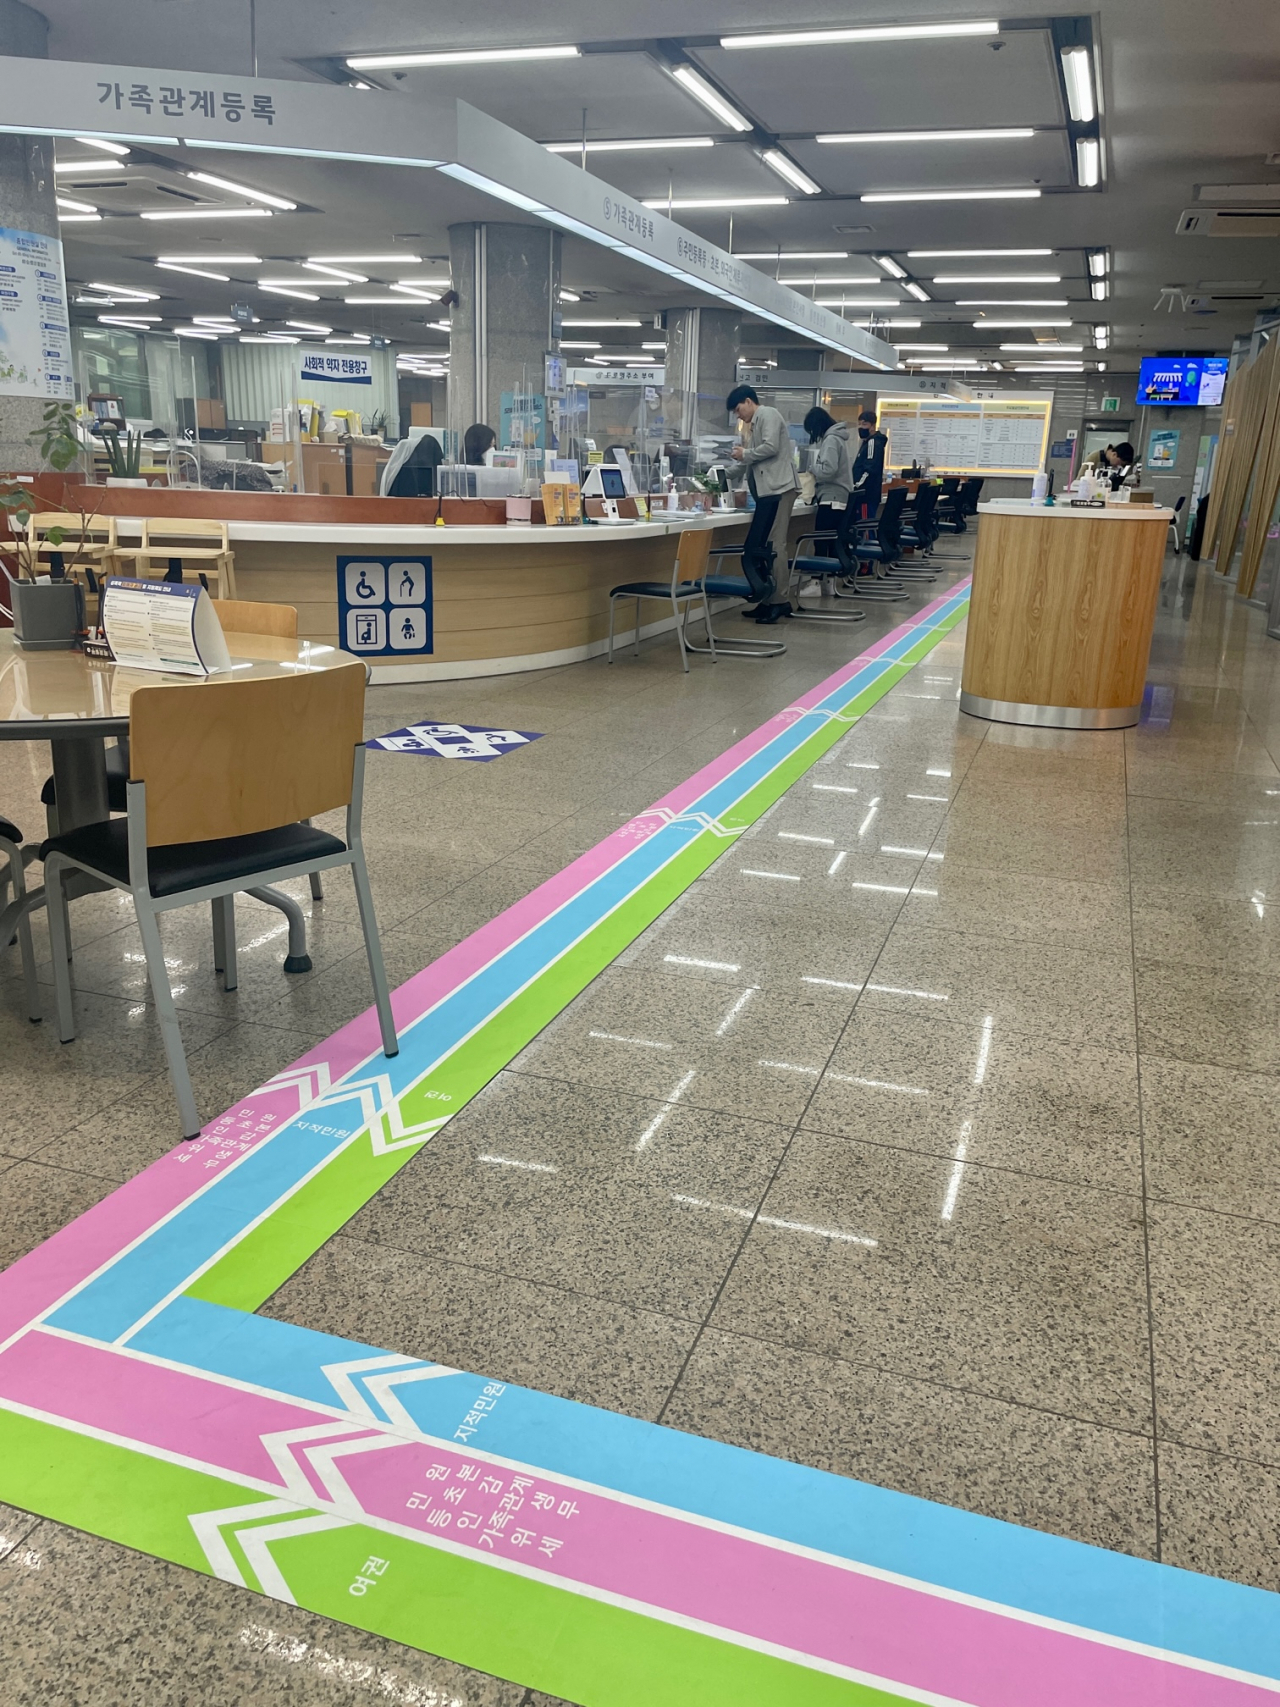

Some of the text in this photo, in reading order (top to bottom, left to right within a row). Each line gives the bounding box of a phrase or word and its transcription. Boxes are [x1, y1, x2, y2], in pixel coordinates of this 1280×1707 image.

[96, 81, 277, 126] 가족관계등록
[613, 202, 654, 242] 가족관계등록
[304, 356, 368, 375] 사회적 약자 전용창구
[423, 1089, 453, 1103] 여권
[200, 1134, 253, 1152] 가족관계
[292, 1119, 352, 1140] 지적민원
[453, 1381, 506, 1442] 지적민원
[478, 1476, 535, 1549] 가족관계
[348, 1555, 391, 1598] 여권
